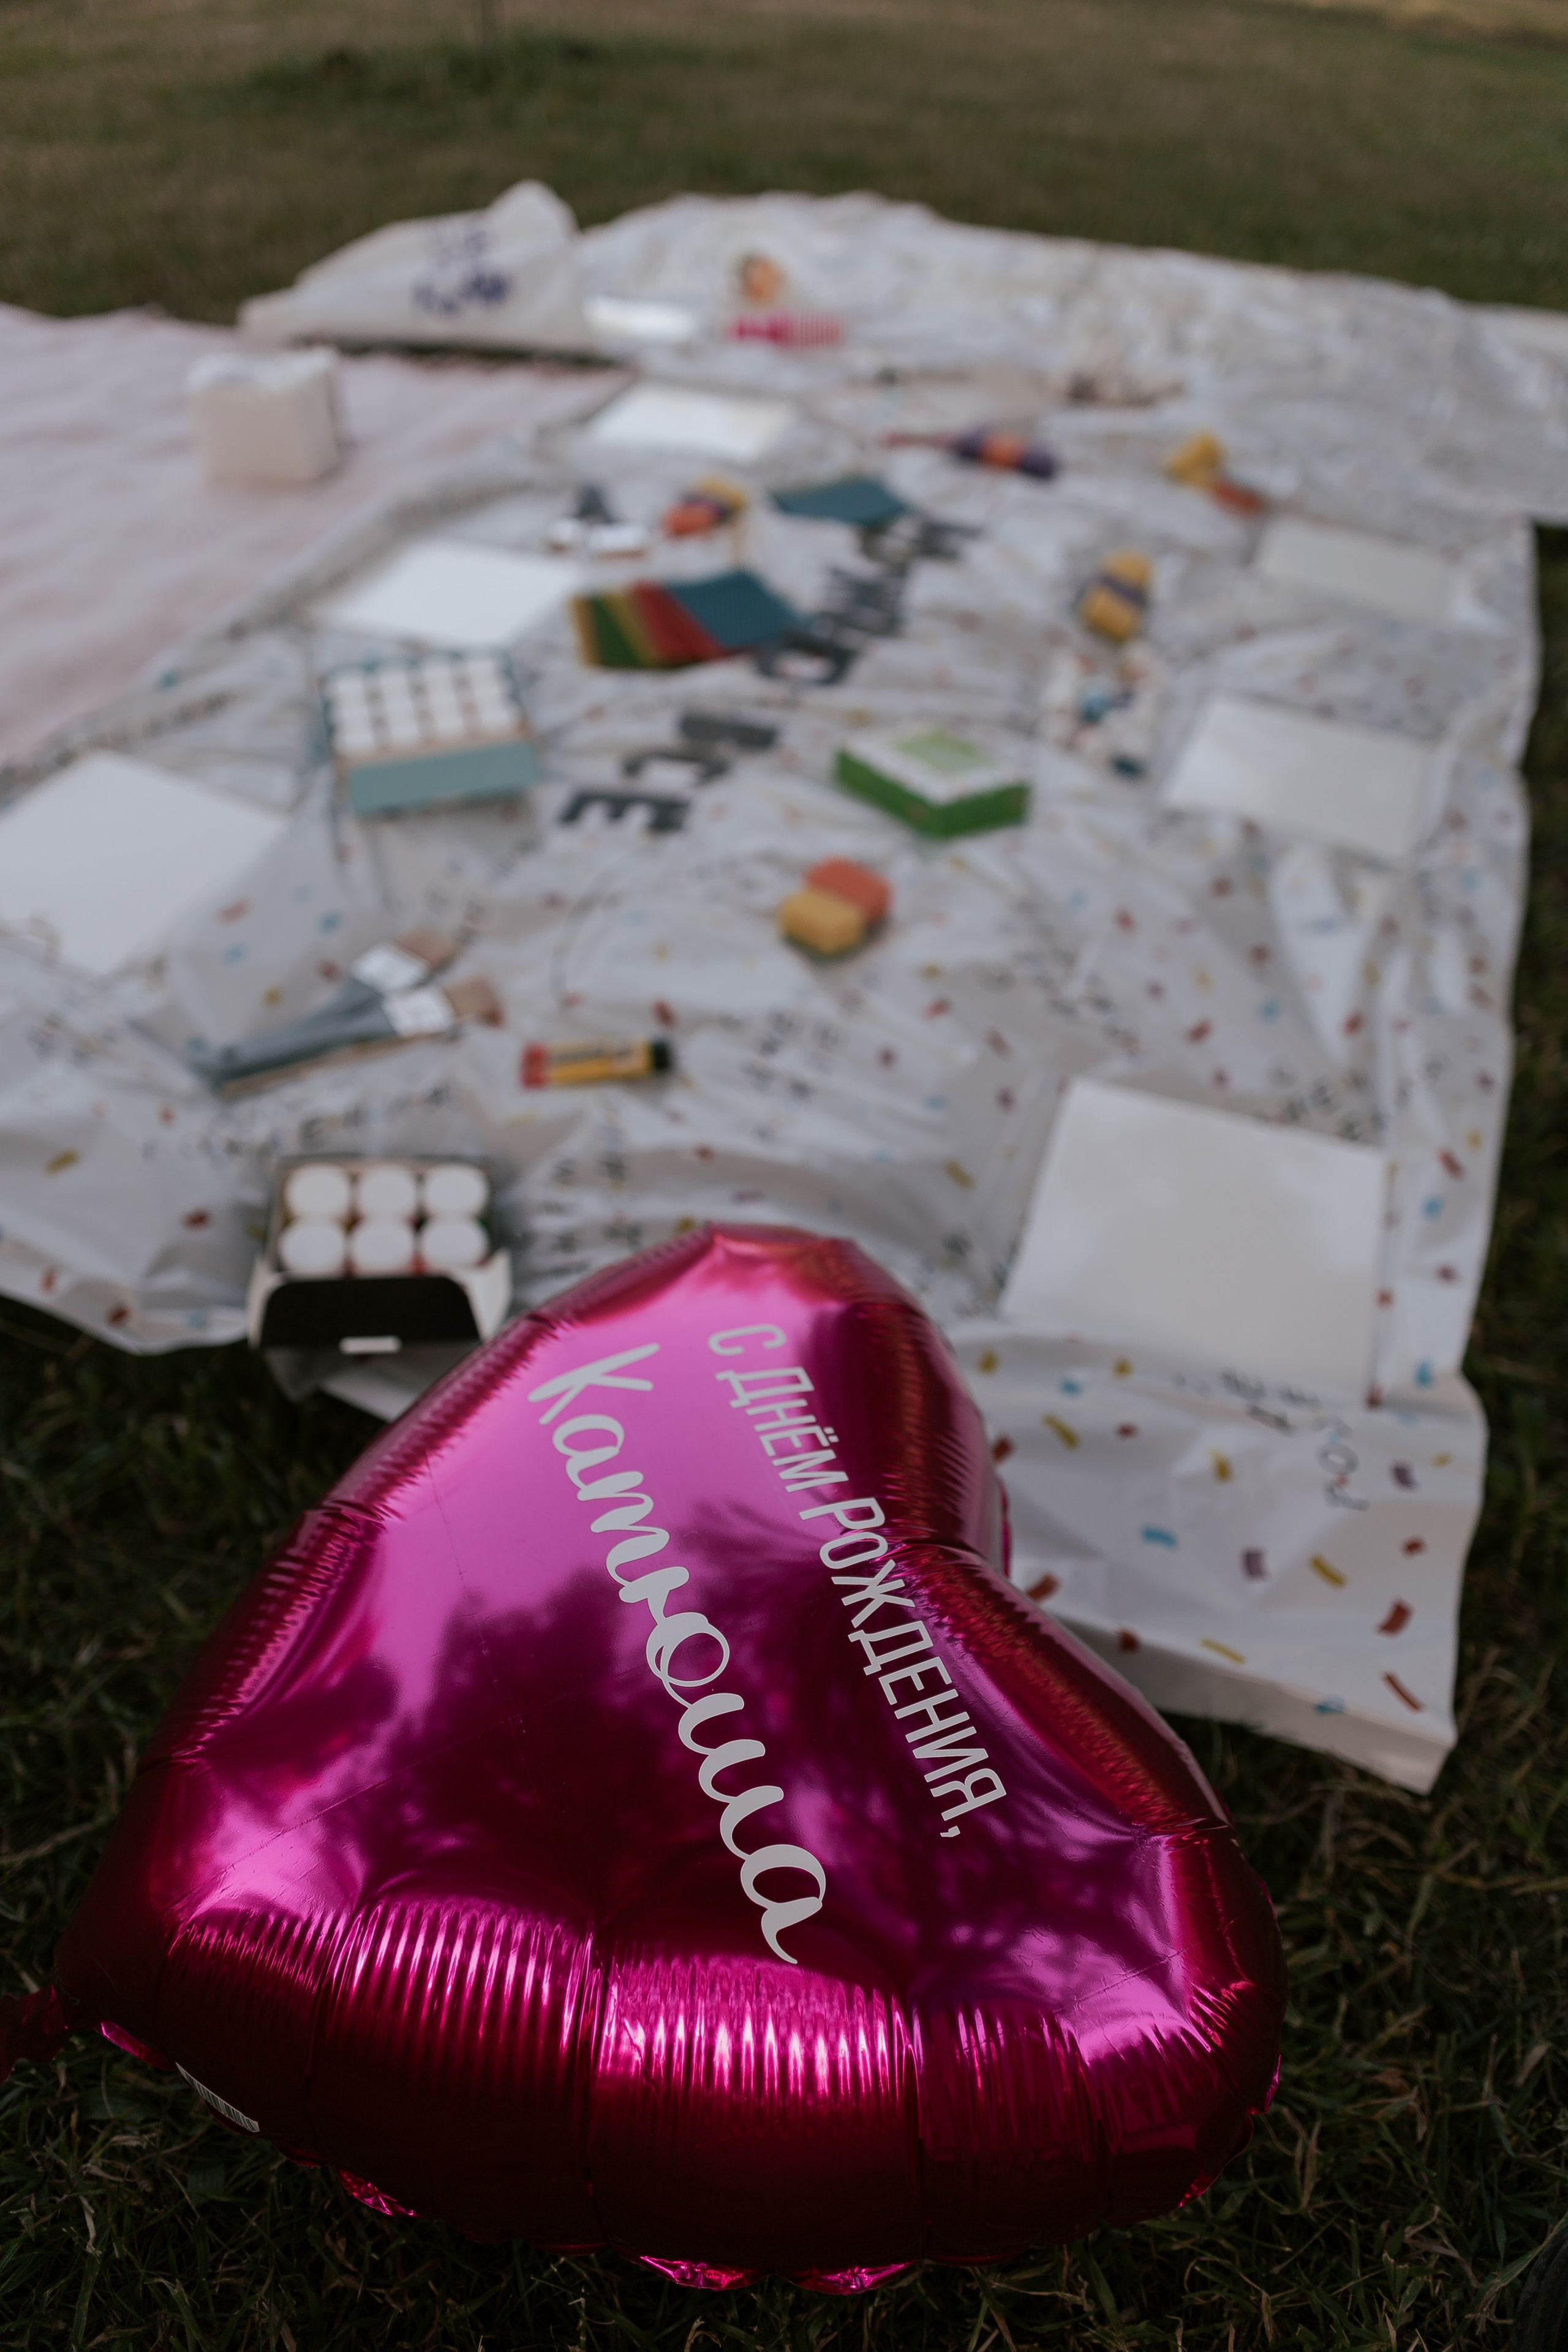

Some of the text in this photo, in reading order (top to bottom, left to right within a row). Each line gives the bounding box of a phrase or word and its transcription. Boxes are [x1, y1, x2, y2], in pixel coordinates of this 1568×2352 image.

[528, 1343, 826, 1964] Катюша
[709, 1324, 1006, 1838] С ДНЁМ РОЖДЕНИЯ,
